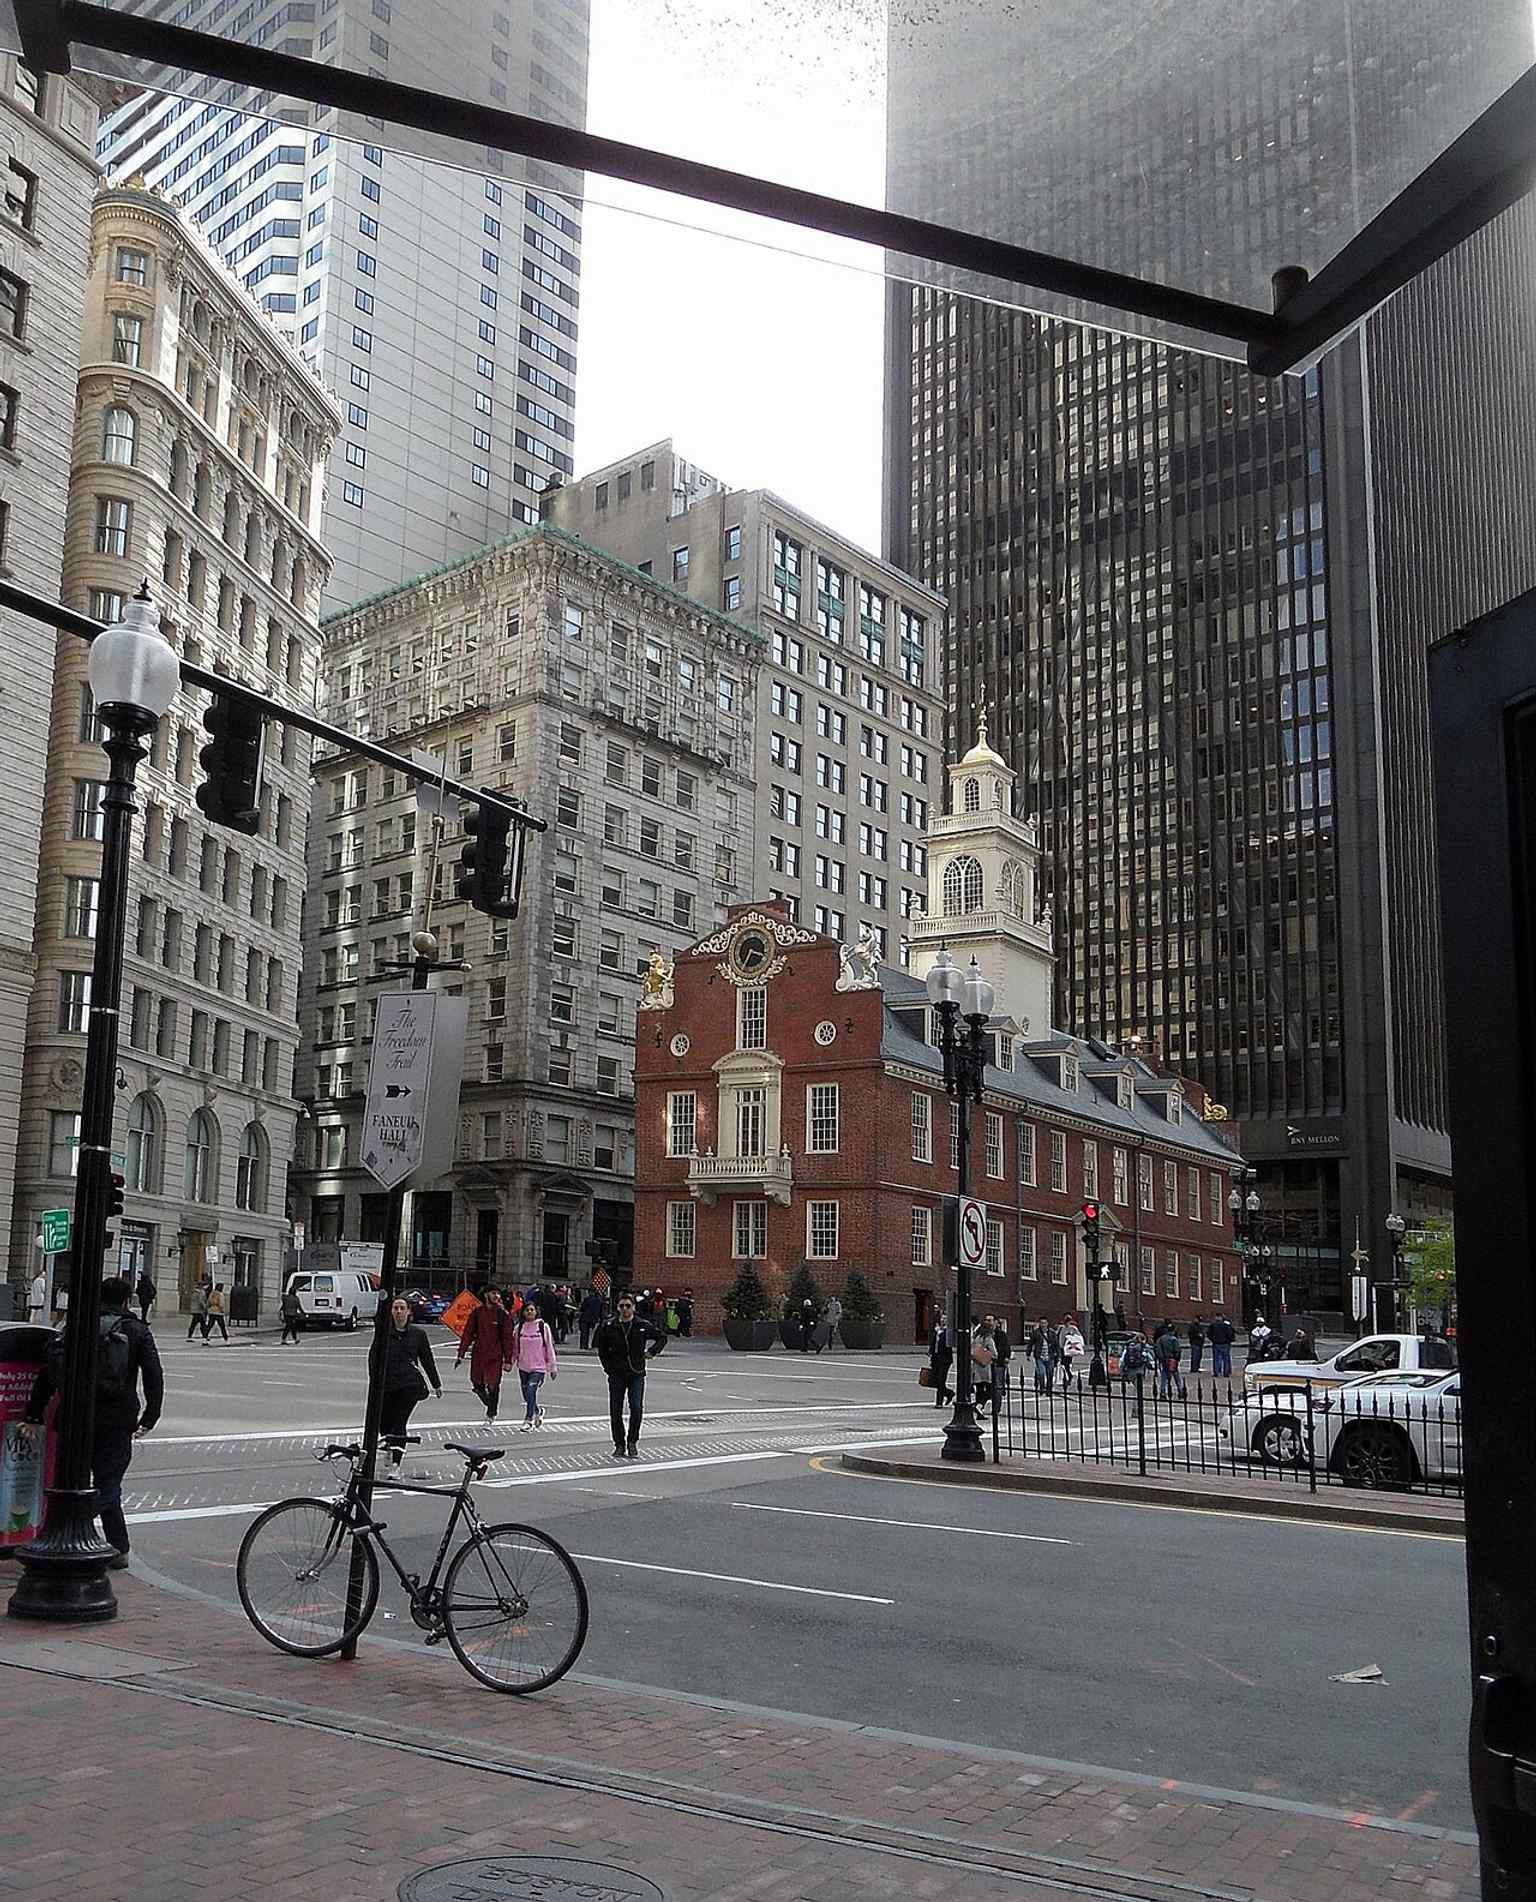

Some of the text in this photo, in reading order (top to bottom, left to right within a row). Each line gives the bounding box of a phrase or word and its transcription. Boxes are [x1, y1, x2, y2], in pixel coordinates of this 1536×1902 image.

[391, 1009, 417, 1029] The
[378, 1029, 427, 1048] Freedom
[385, 1050, 418, 1070] Trail
[379, 1128, 407, 1141] HALL
[1291, 1135, 1340, 1145] BNY MELLON
